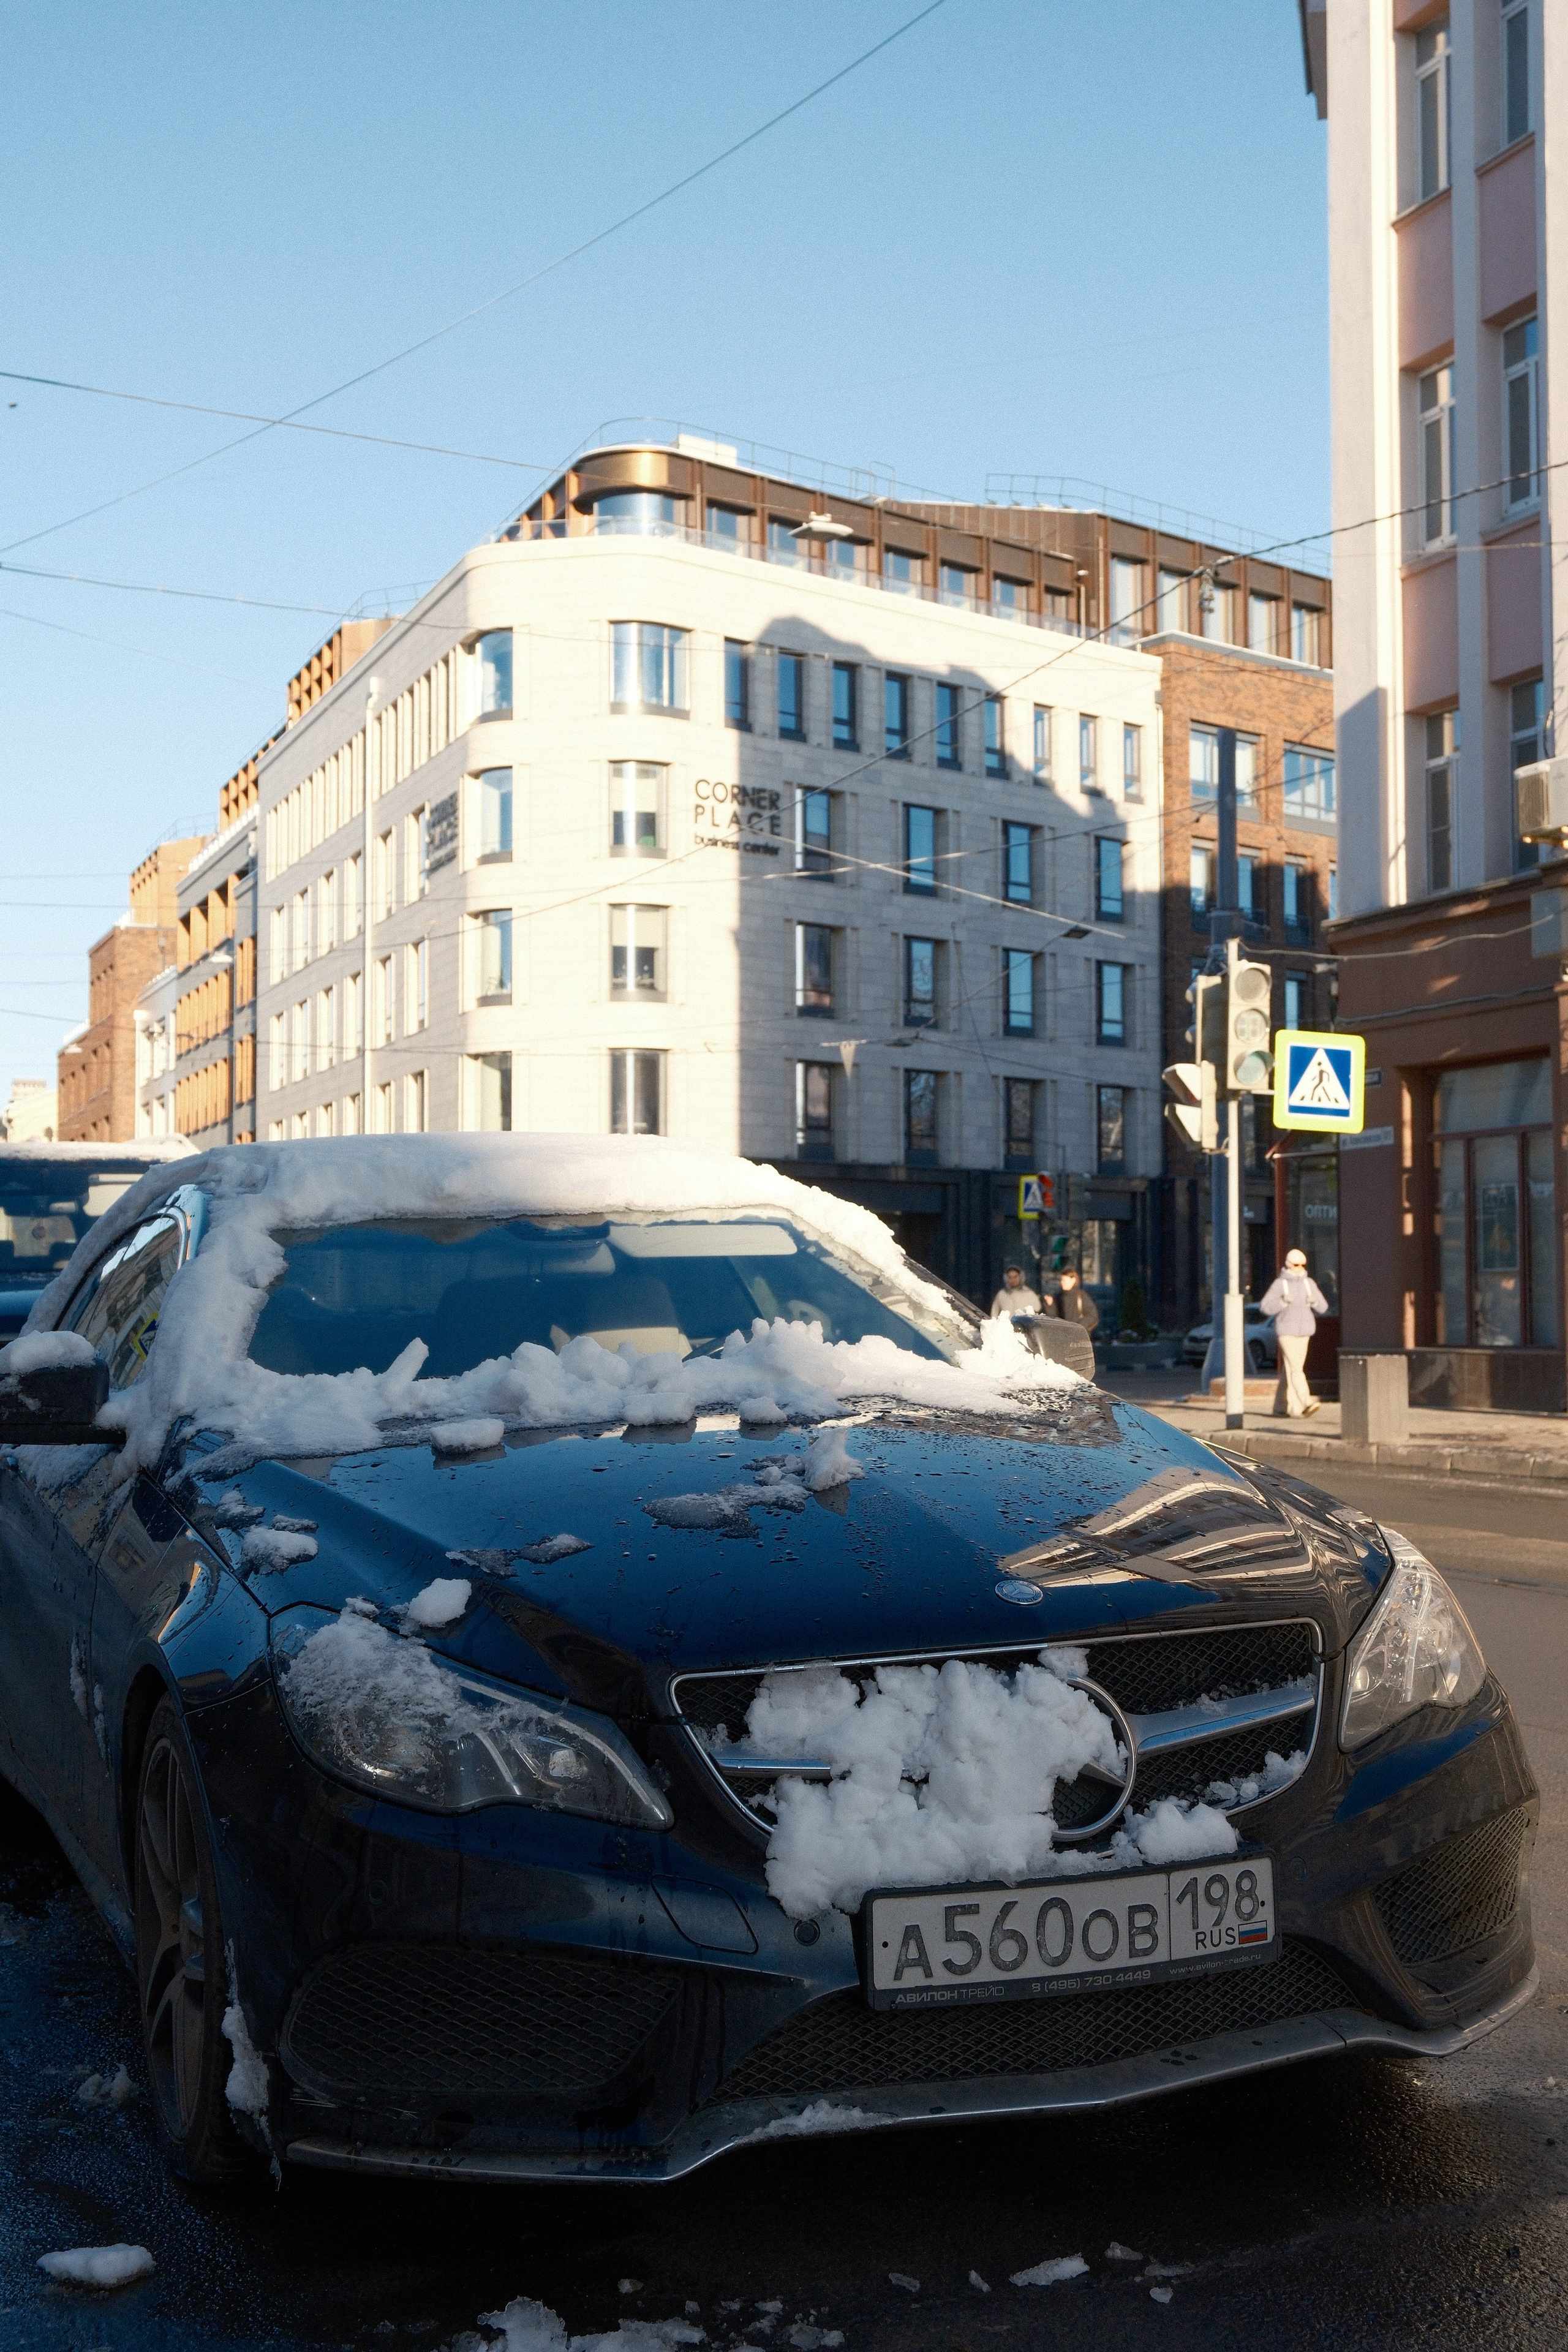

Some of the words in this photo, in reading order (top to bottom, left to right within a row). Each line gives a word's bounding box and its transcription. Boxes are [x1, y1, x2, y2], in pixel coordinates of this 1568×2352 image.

[695, 779, 780, 810] CORNER
[694, 804, 782, 836] PLACE
[1175, 1869, 1260, 1930] 198
[1195, 1926, 1237, 1951] RUS
[895, 1989, 958, 2004] АВИЛОН
[959, 1985, 1005, 1999] ТРЕЙД
[1044, 1978, 1080, 1992] (495)
[1084, 1969, 1152, 1987] 730-4449
